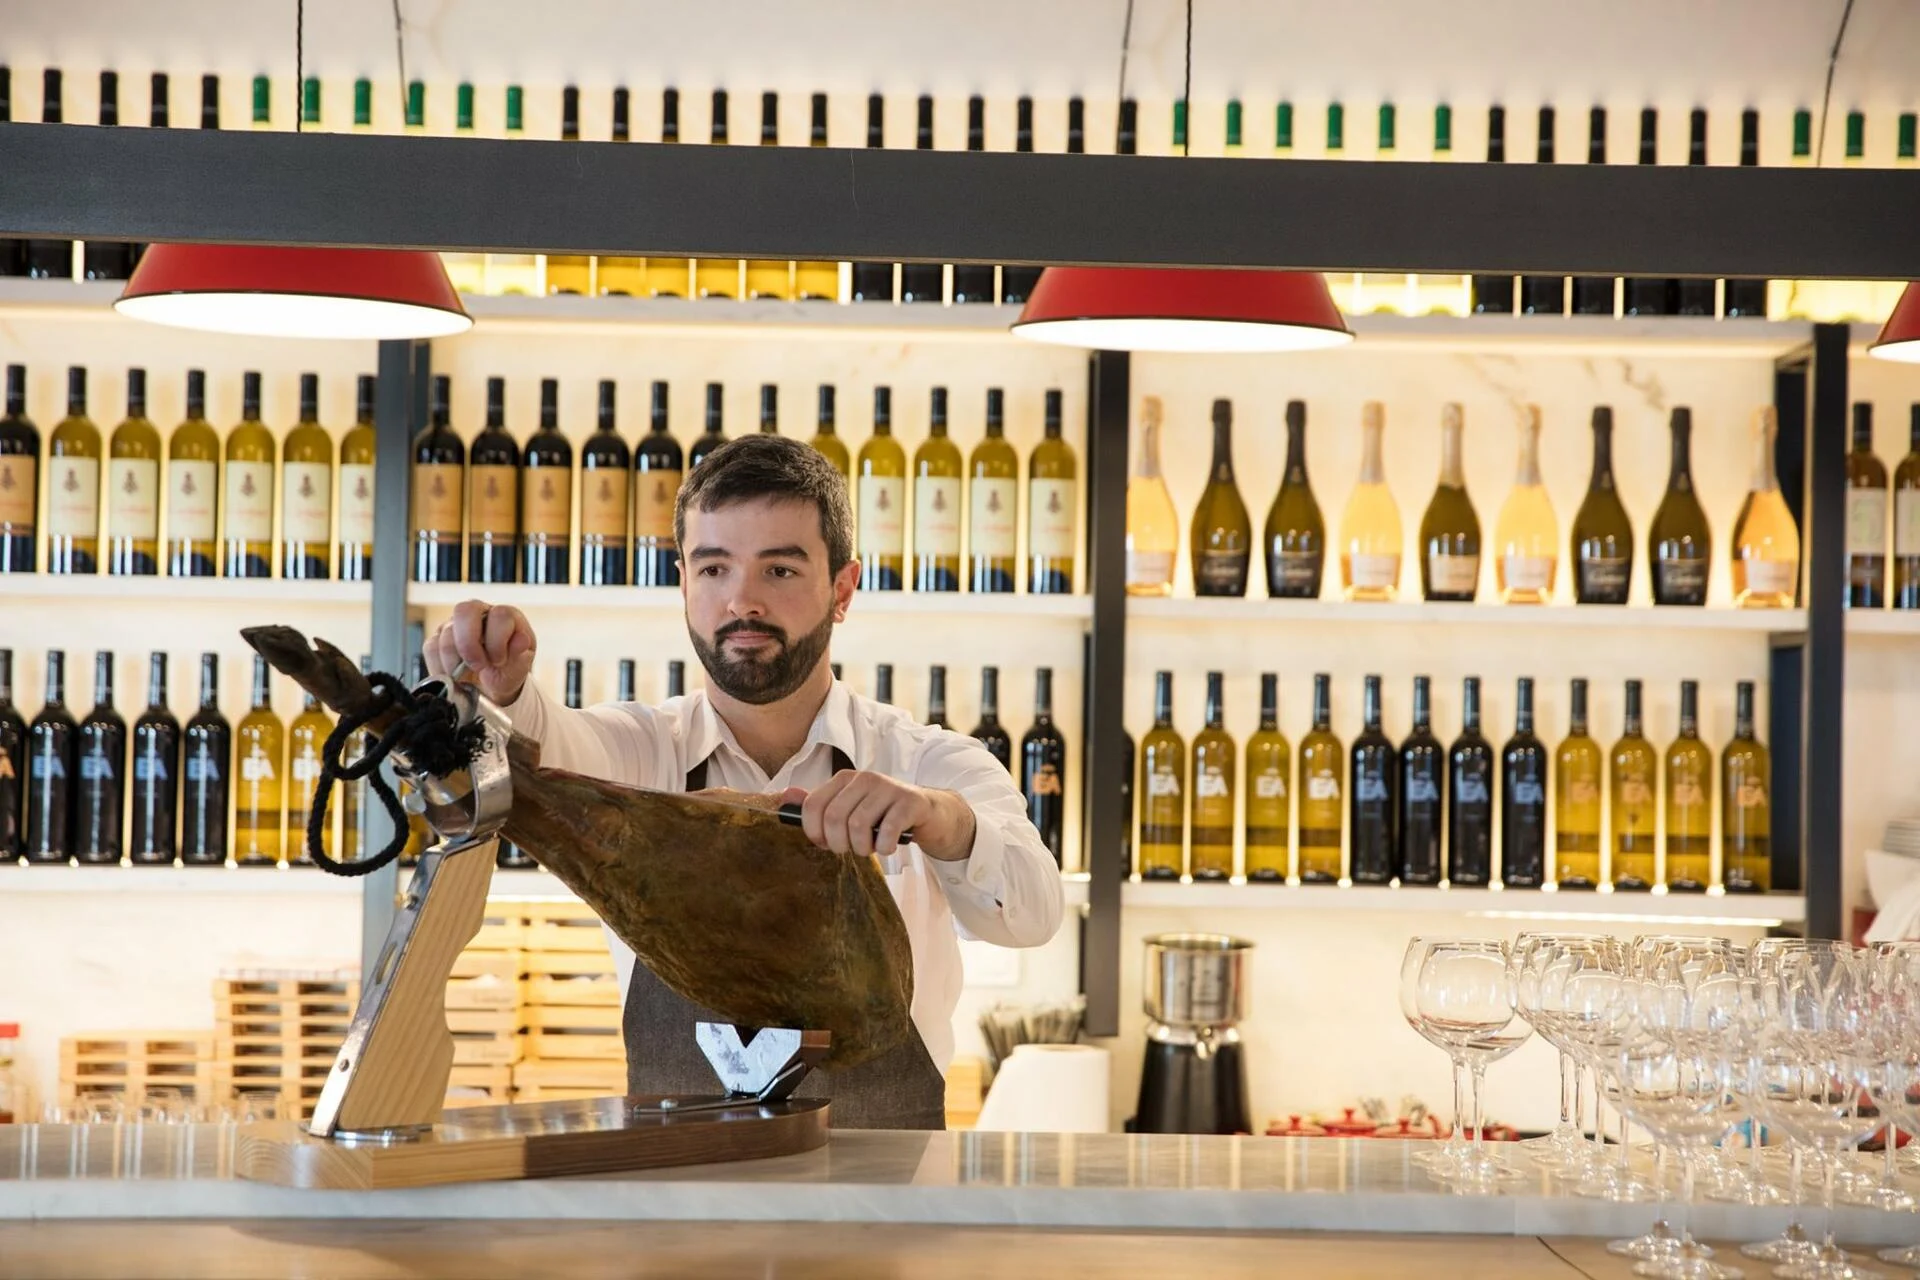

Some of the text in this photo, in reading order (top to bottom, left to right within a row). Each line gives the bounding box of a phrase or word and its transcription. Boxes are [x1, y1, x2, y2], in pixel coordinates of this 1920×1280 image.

[1151, 773, 1180, 796] EA
[1197, 774, 1228, 797] EA
[1256, 775, 1286, 798] EA
[1309, 777, 1340, 799] EA
[1358, 779, 1388, 801] EA
[1407, 780, 1439, 802] EA
[1457, 781, 1488, 802] EA
[1515, 782, 1543, 804] EA
